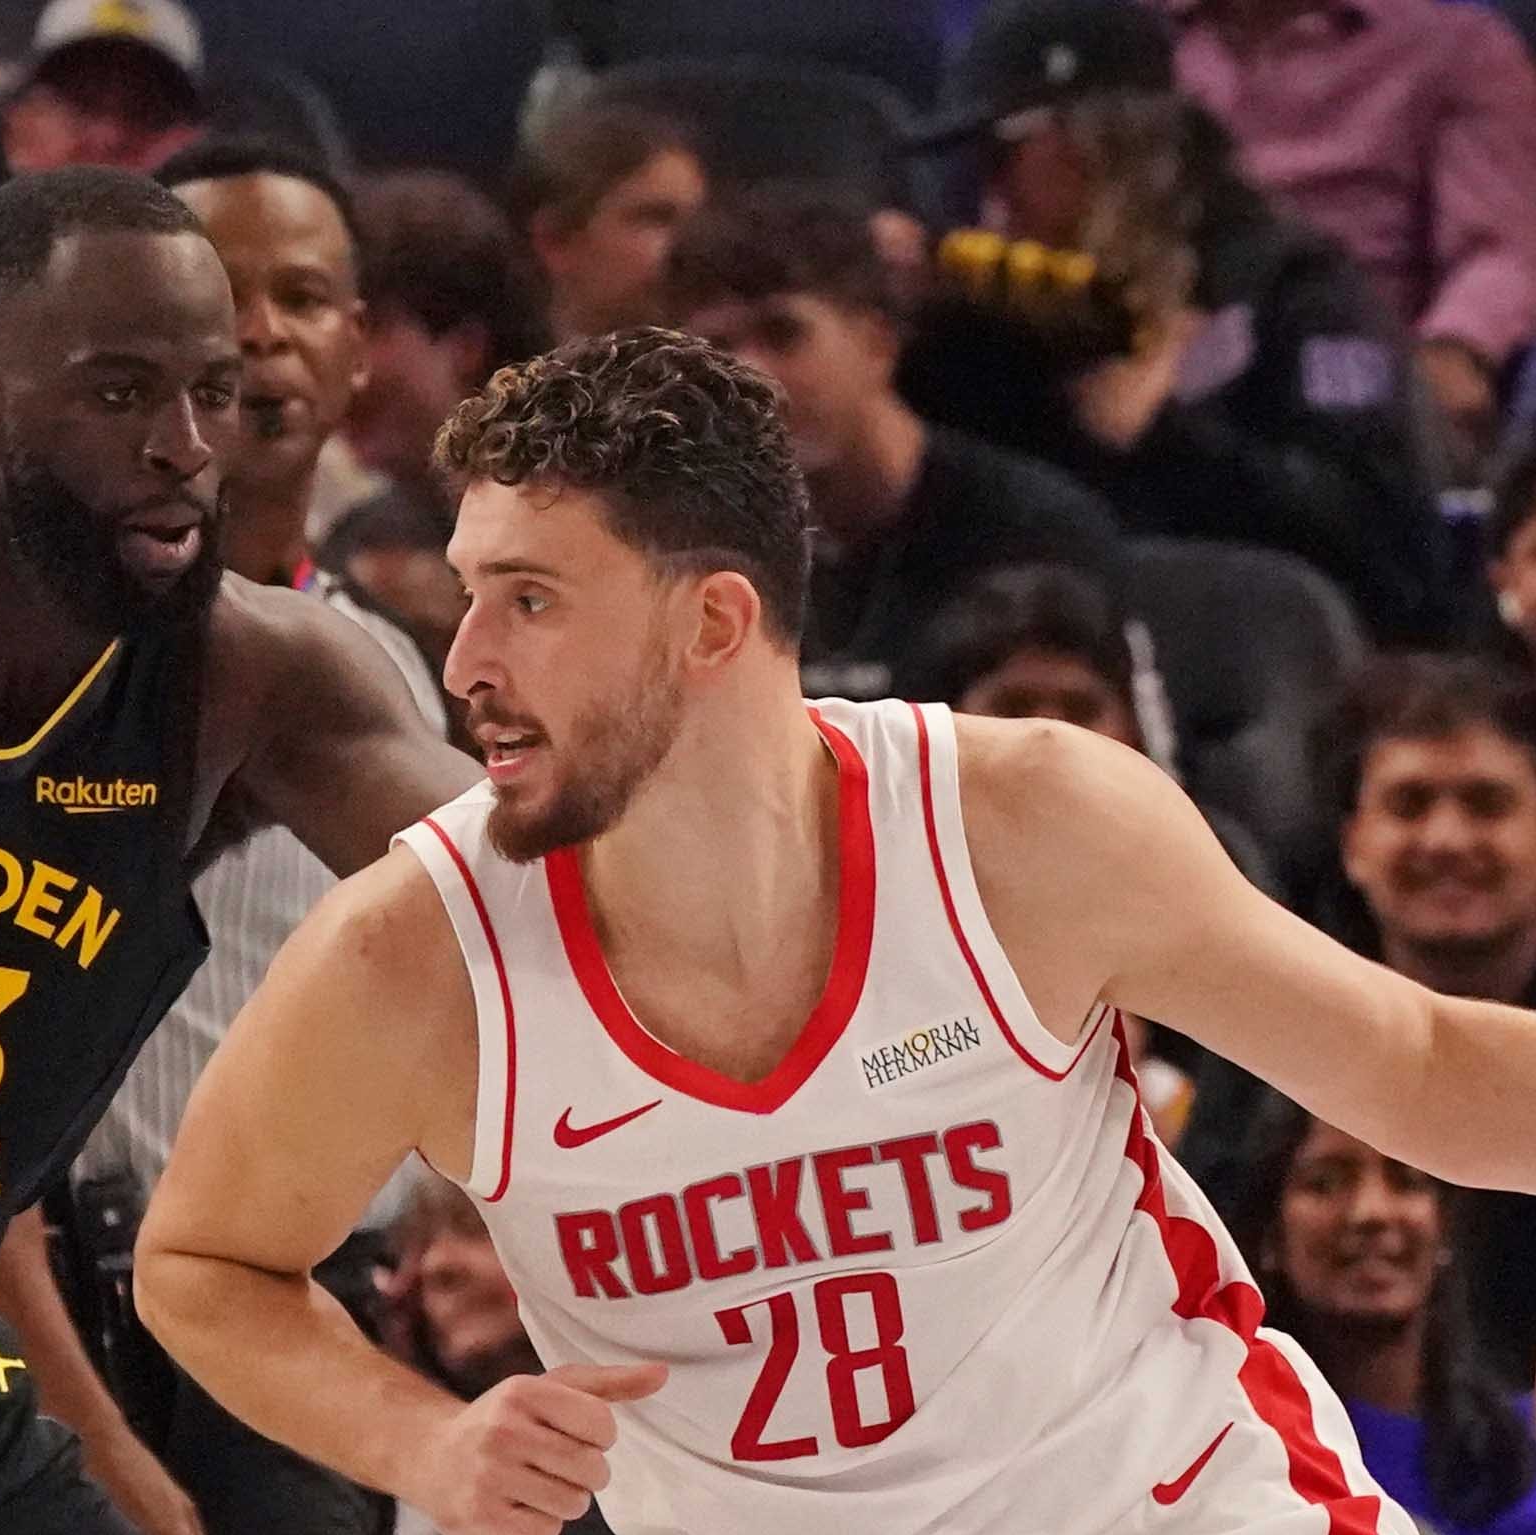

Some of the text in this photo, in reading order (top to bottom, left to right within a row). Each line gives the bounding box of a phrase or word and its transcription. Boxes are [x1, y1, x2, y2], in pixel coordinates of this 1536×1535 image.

[36, 775, 157, 806] Rakuten
[861, 1016, 977, 1071] MEMORIAL
[865, 1027, 981, 1089] HERMANN
[553, 1119, 1013, 1300] ROCKETS
[714, 1271, 916, 1462] 28
